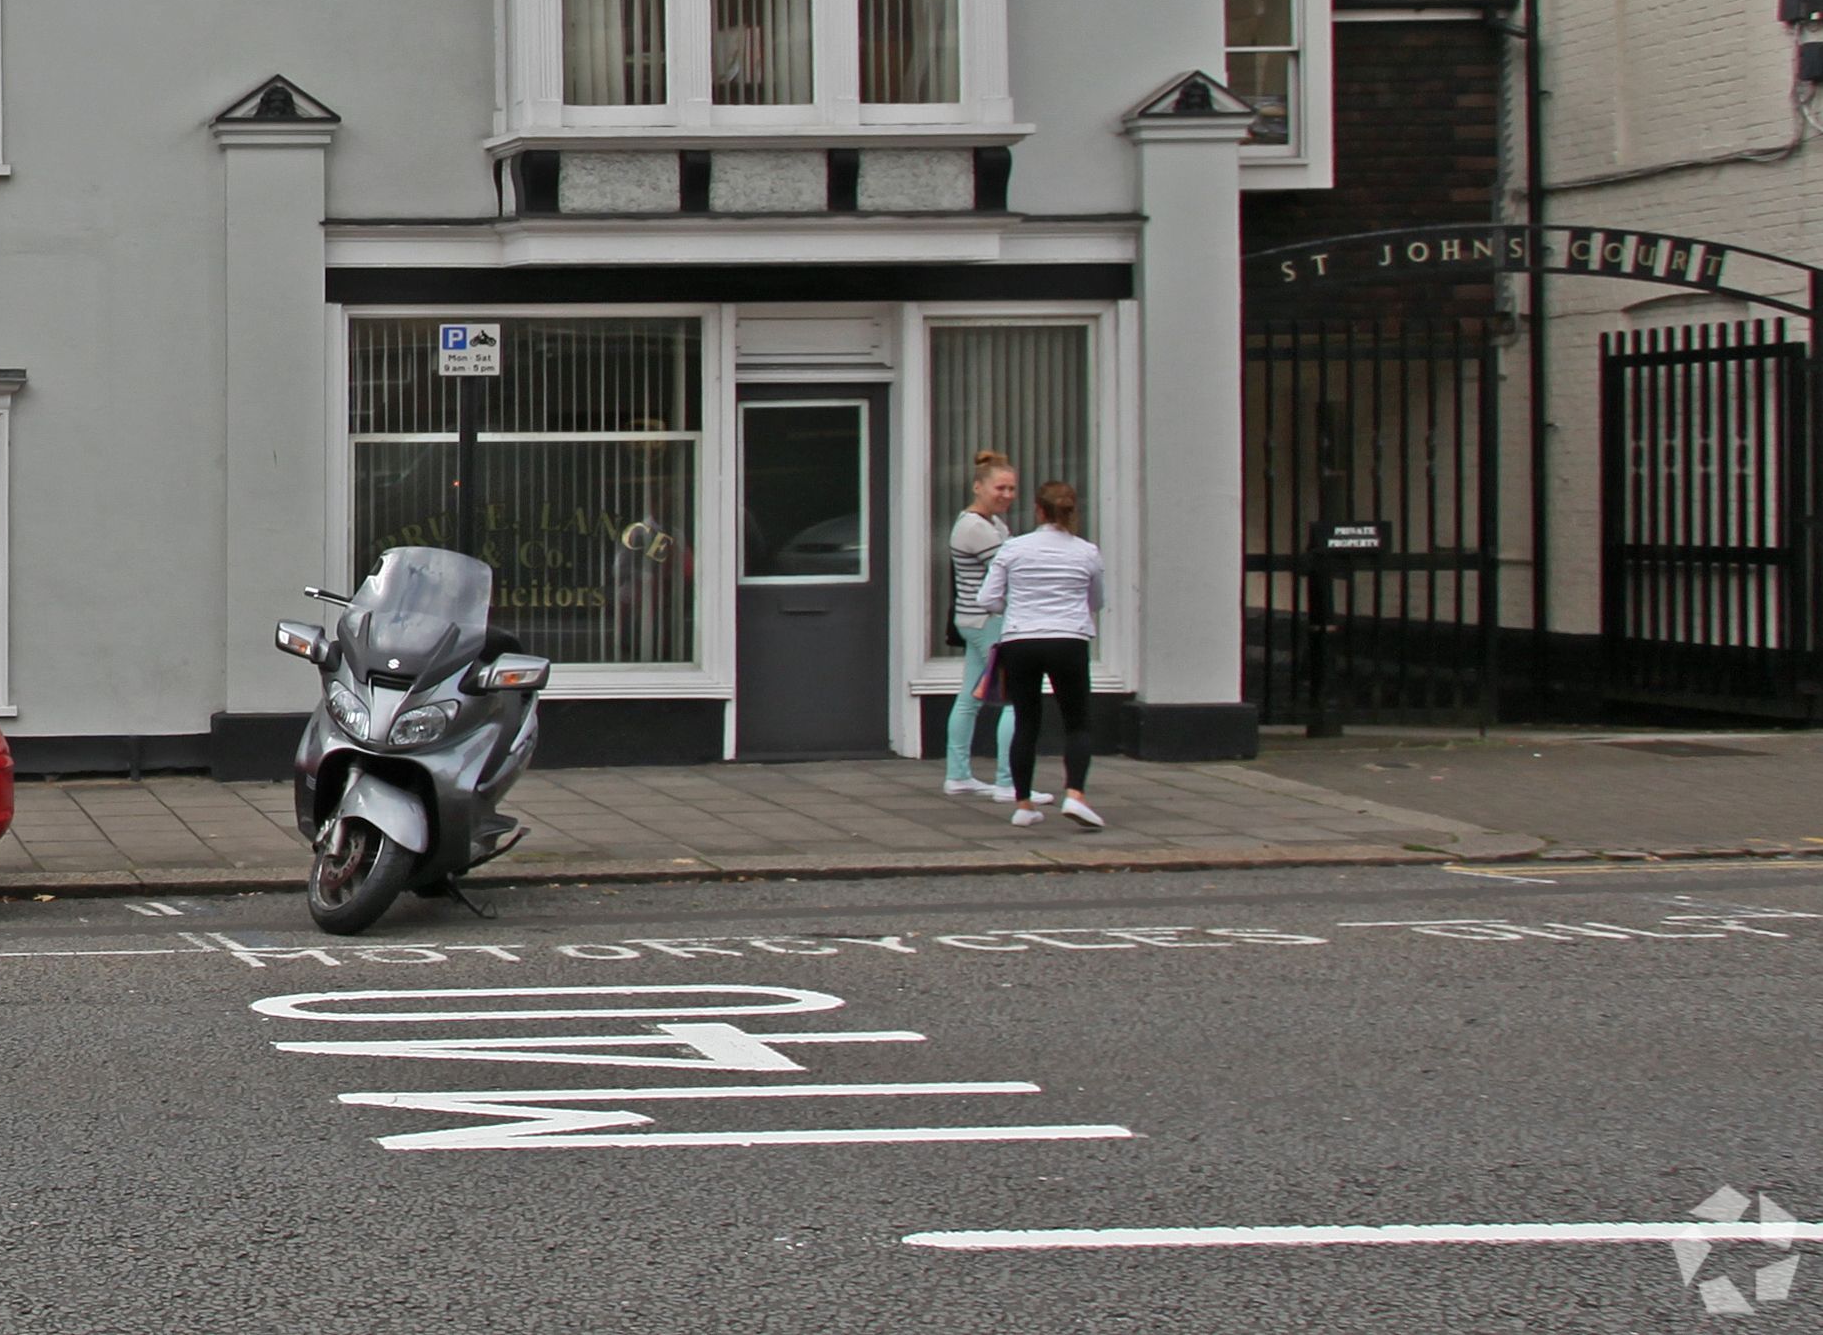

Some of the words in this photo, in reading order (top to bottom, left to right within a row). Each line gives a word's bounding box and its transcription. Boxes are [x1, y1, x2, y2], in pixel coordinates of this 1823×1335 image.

[1280, 253, 1330, 283] ST
[1378, 237, 1525, 267] JOHNS
[1571, 240, 1723, 277] COURT
[448, 354, 468, 362] Mon
[475, 354, 492, 362] Sat
[540, 502, 674, 563] LANCE
[1327, 538, 1380, 548] PROPERTY
[480, 541, 503, 569] &
[520, 541, 573, 569] Co.
[491, 578, 607, 608] icitors
[230, 927, 1330, 967] MOTORCYCLES
